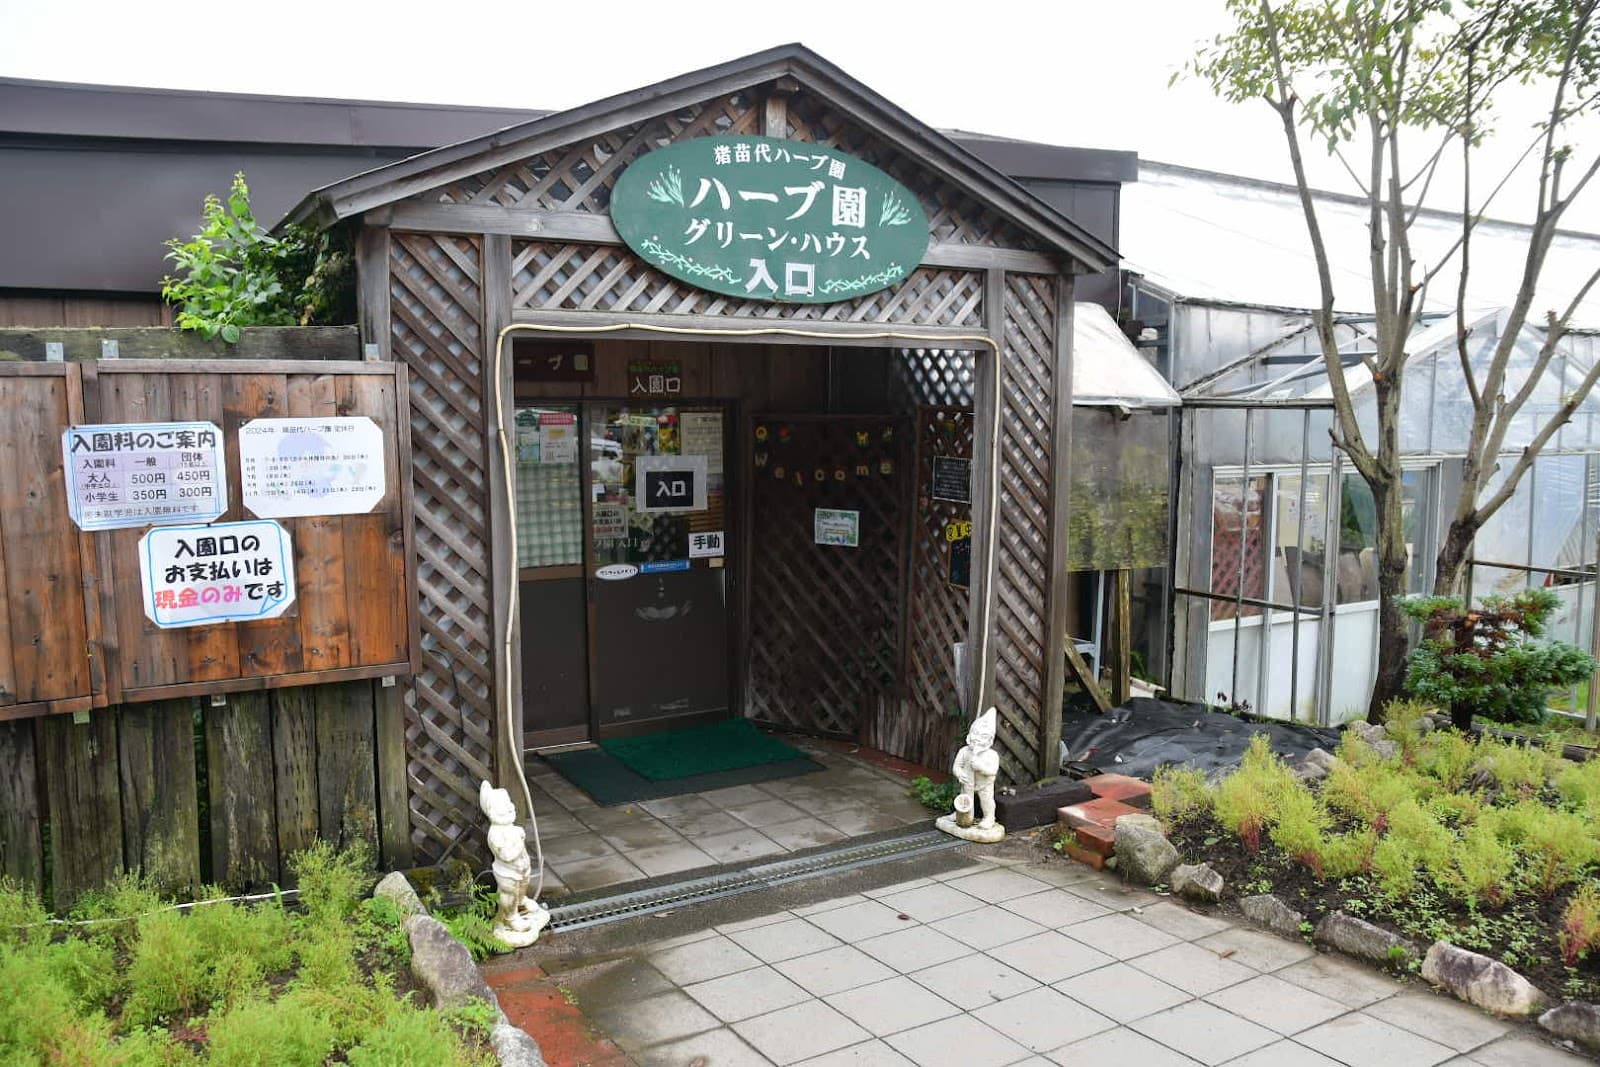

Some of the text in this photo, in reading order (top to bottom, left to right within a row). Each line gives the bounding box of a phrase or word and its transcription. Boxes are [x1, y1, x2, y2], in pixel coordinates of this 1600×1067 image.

[714, 143, 846, 180] 猪苗代ハーブ園
[690, 177, 867, 229] ハーブ園
[684, 217, 871, 260] グリーン・ハウス
[745, 258, 816, 297] 入口
[632, 375, 681, 393] 入園口
[72, 430, 216, 452] 入園料のご案内
[83, 458, 116, 470] 入園料
[135, 456, 156, 468] 一般
[181, 452, 202, 463] 団体
[87, 472, 111, 485] 大人
[131, 472, 166, 485] 500円
[176, 470, 210, 483] 450円
[85, 491, 119, 502] 小学生
[133, 488, 167, 501] 350円
[178, 486, 212, 499] 300円
[656, 480, 687, 498] 入口
[174, 534, 260, 559] 入園口の
[694, 533, 720, 550] 手動
[165, 558, 273, 583] お支払いは
[155, 580, 284, 608] 現金のみです
